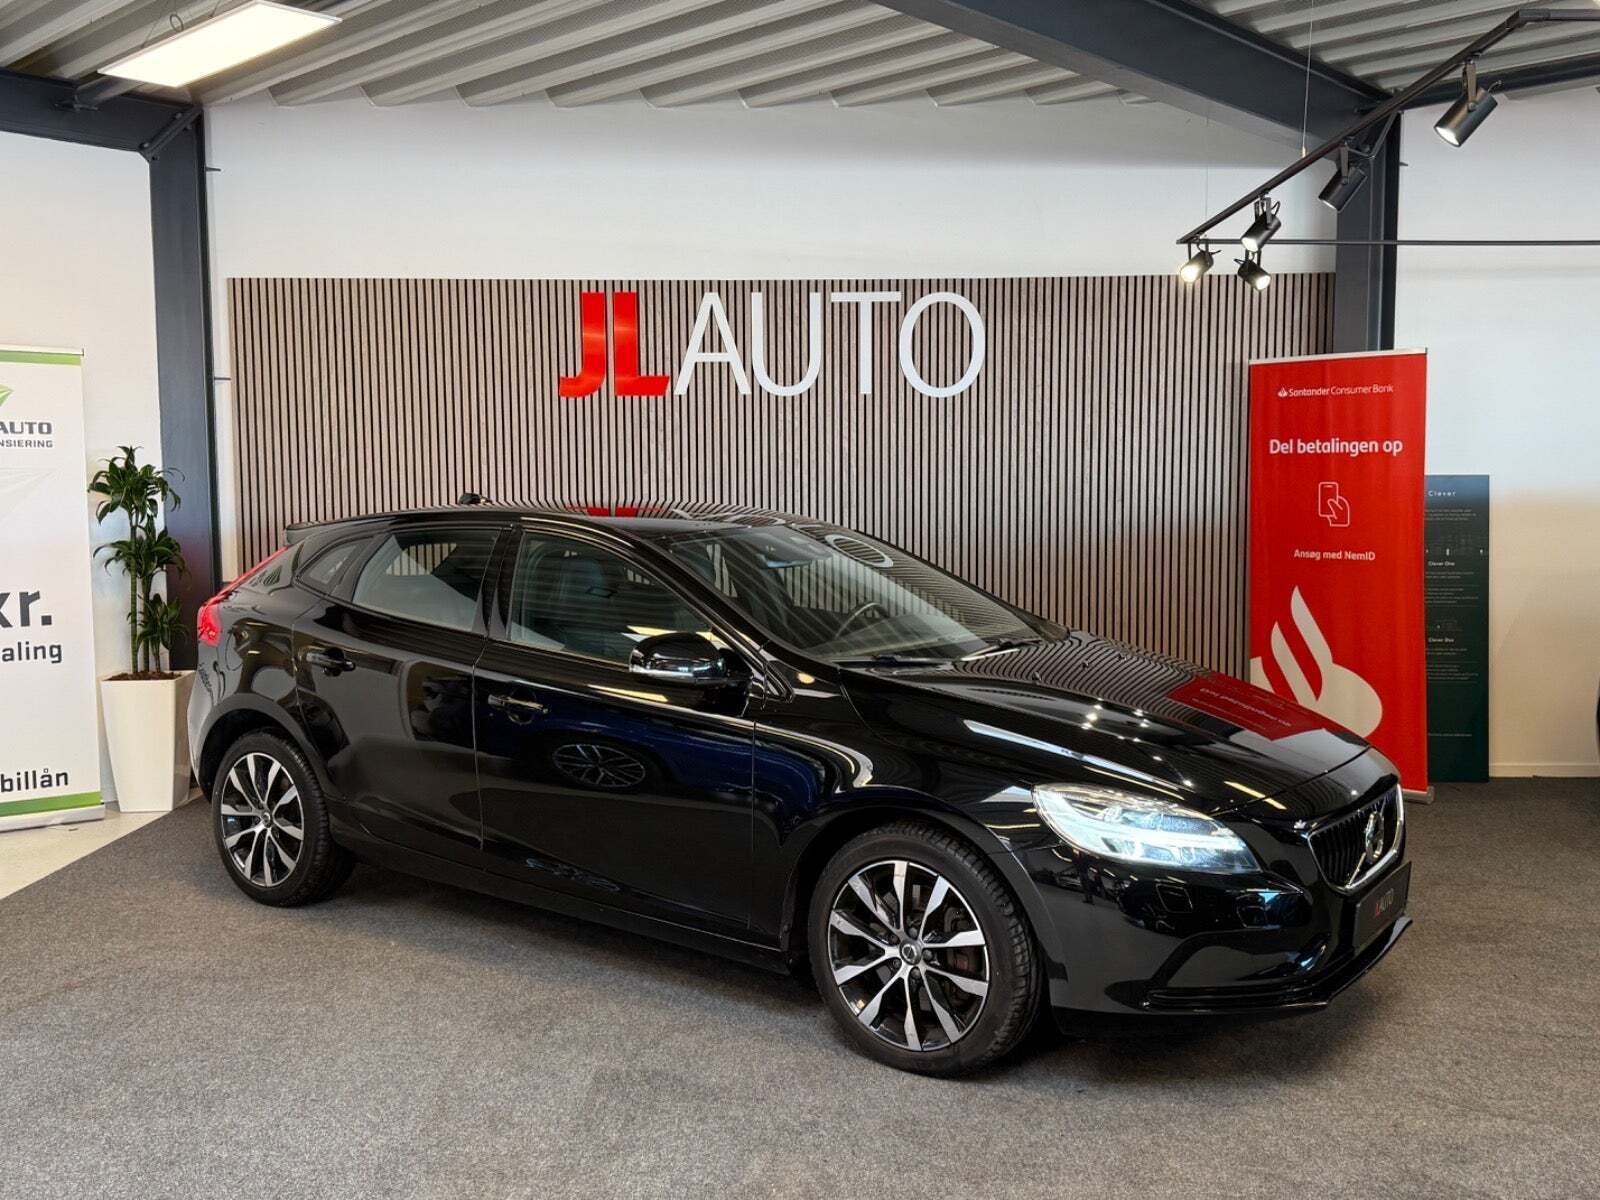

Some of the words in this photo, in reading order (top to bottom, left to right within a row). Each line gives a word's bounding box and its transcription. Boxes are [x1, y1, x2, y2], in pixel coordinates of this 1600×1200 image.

[1289, 387, 1329, 397] Santander
[1331, 385, 1371, 395] Consumer
[1373, 384, 1394, 393] Bank
[1269, 439, 1293, 454] Del
[1297, 438, 1379, 457] betalingen
[1382, 440, 1403, 456] op
[1294, 549, 1321, 560] Ansøg
[1322, 551, 1342, 560] med
[1344, 550, 1376, 560] NemID
[1, 641, 63, 664] aling
[0, 768, 69, 793] billån
